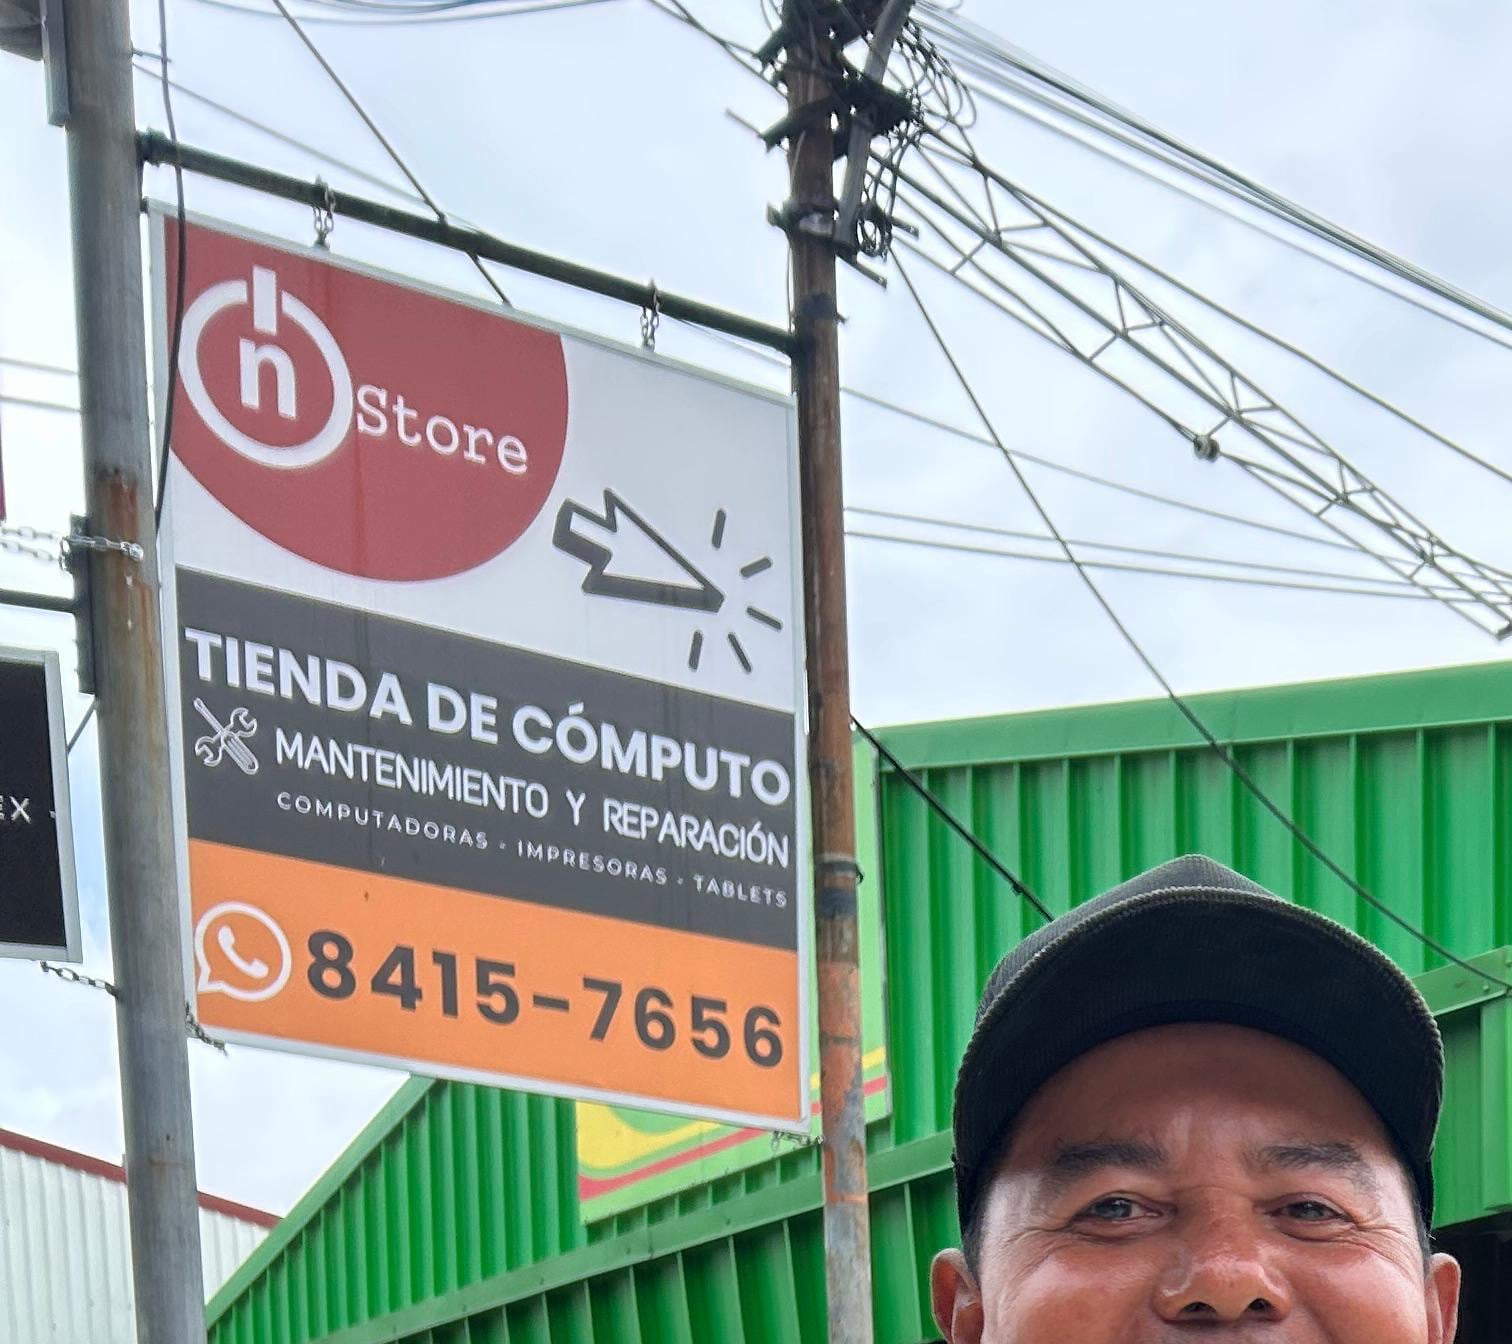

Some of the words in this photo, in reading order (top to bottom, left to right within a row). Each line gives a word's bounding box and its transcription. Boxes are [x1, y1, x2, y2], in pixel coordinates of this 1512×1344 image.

[356, 384, 528, 474] Store
[185, 627, 413, 726] TIENDA
[427, 681, 498, 744] DE
[512, 702, 790, 806] CÓMPUTO
[275, 727, 549, 818] MANTENIMIENTO
[565, 788, 586, 826] Y
[603, 798, 789, 868] REPARACIÓN
[277, 791, 488, 849] COMPUTADORAS
[517, 840, 668, 885] IMPRESORAS
[694, 874, 788, 908] TABLETS
[307, 928, 783, 1067] 8415-7656
